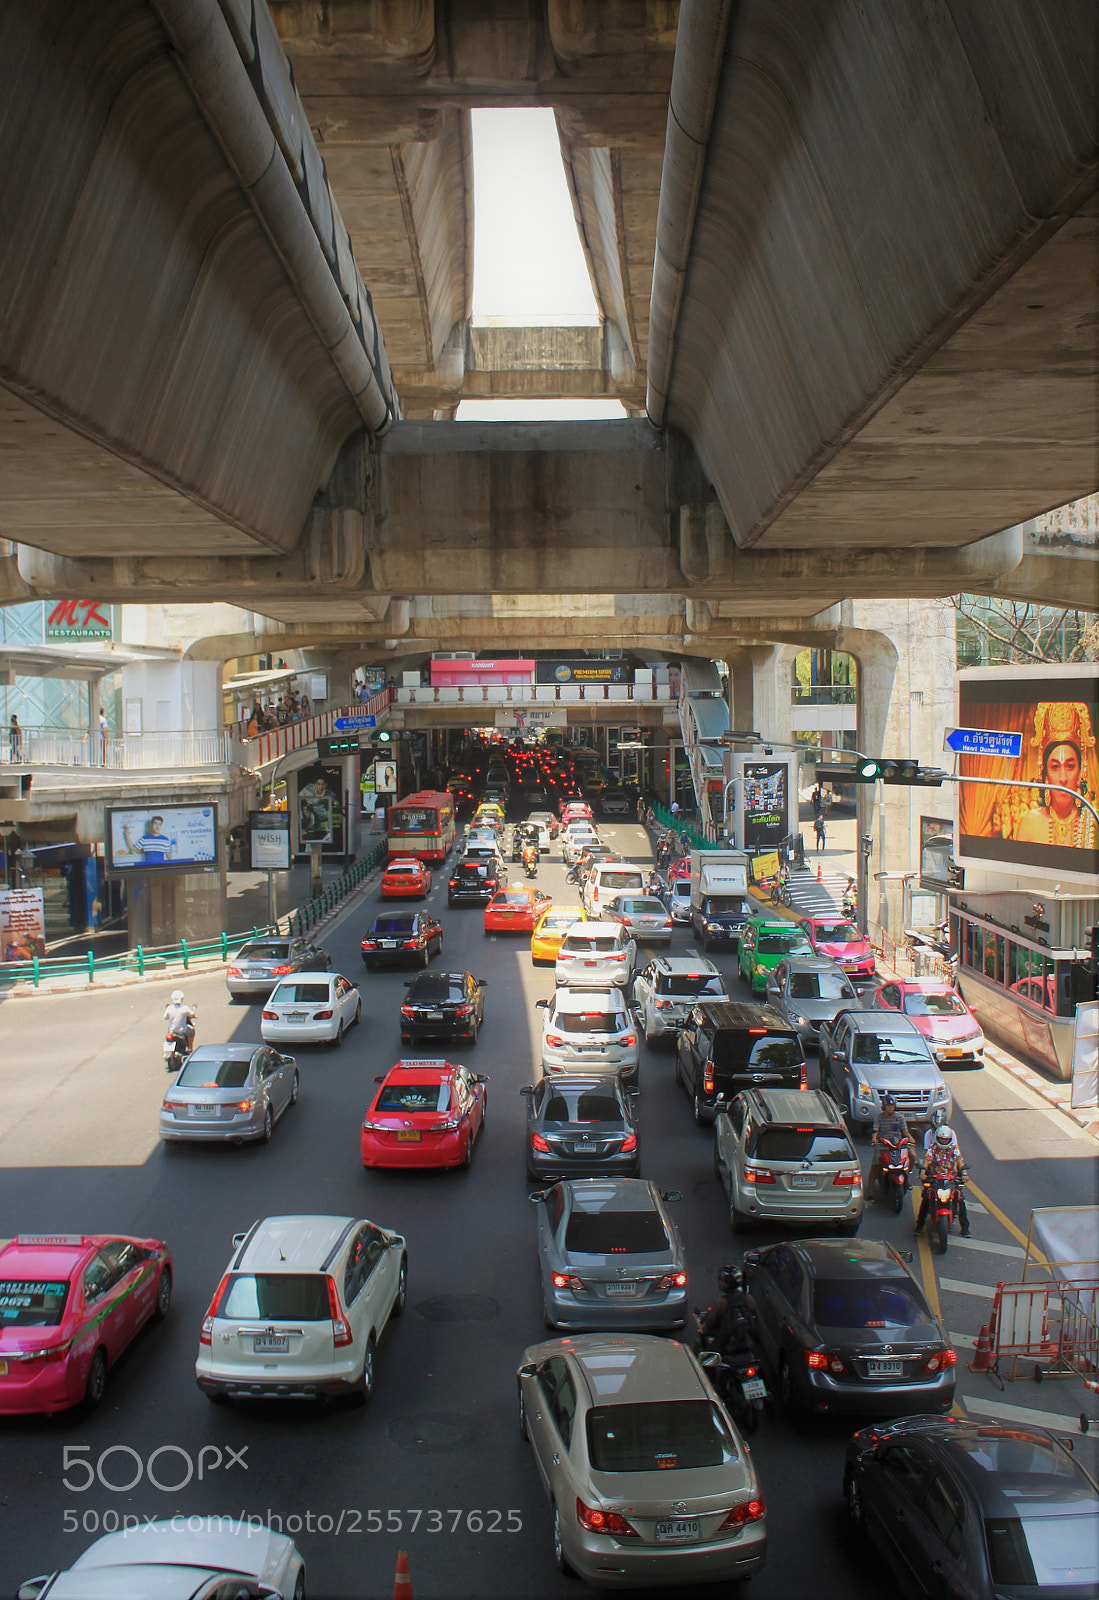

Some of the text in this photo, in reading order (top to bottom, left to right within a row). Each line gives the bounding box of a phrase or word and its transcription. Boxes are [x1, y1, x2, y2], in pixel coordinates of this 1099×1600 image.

[47, 599, 108, 627] MK
[48, 629, 111, 637] RESTAURANTS
[530, 711, 550, 720] สยาม
[676, 1522, 698, 1533] 4410
